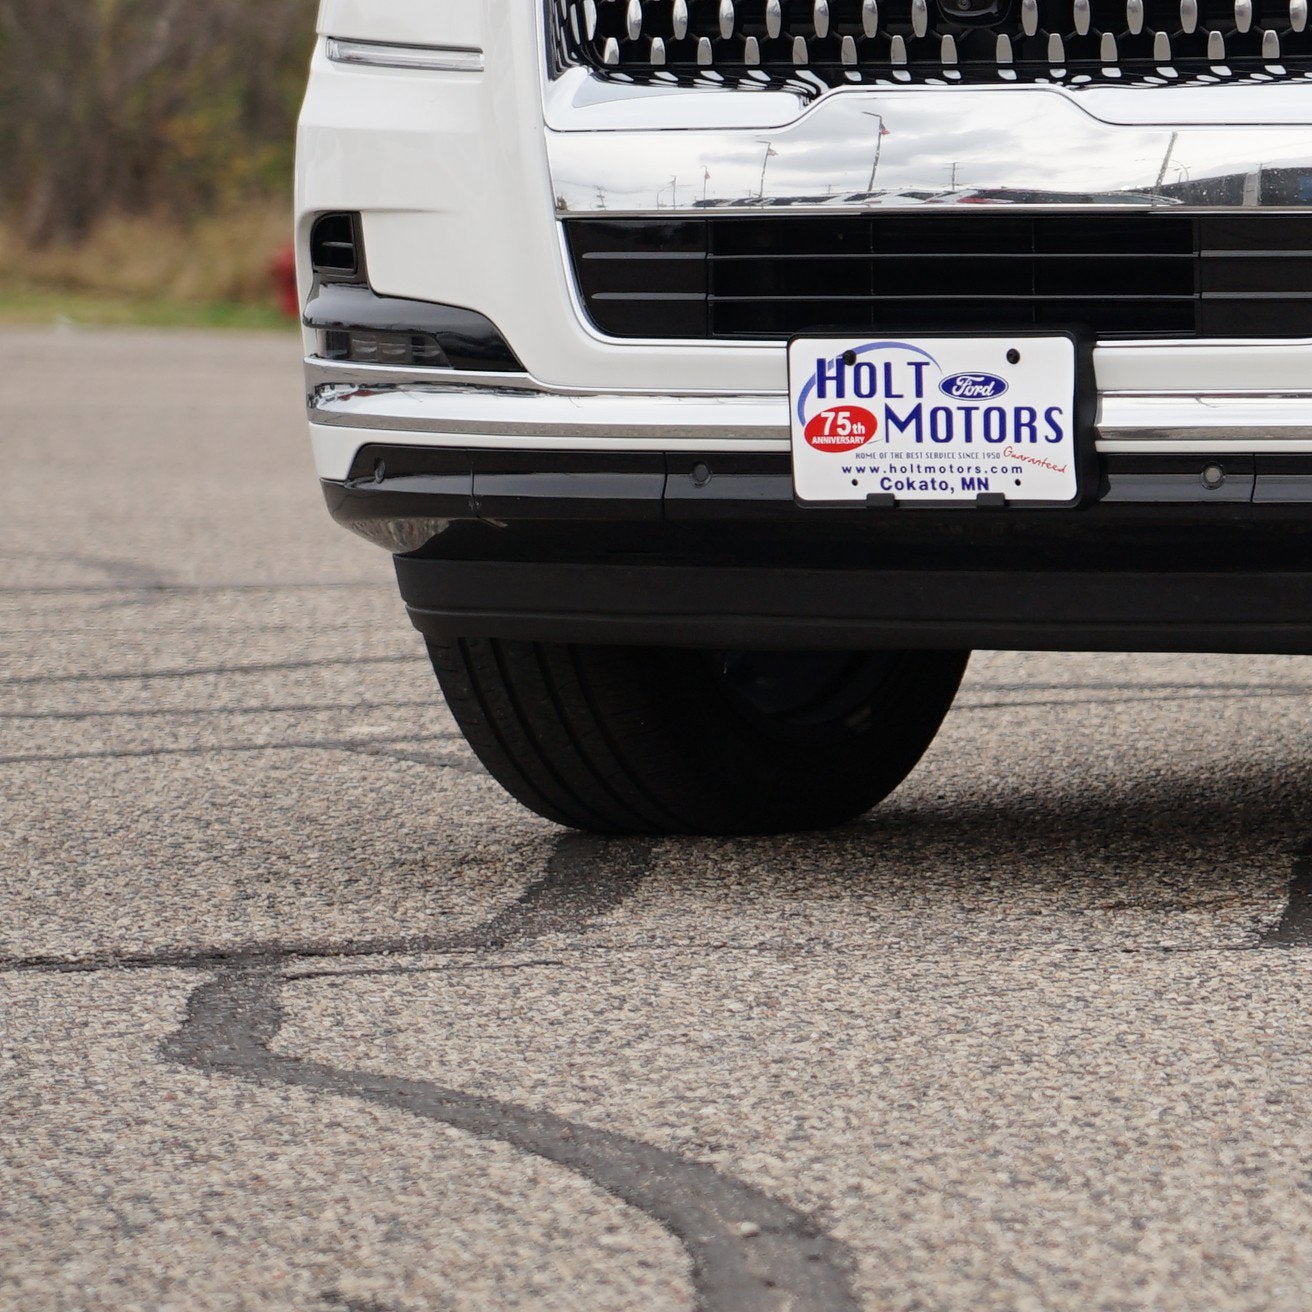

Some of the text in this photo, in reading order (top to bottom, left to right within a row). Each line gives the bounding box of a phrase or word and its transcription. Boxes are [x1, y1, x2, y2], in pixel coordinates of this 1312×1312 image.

[816, 358, 930, 399] HOLT
[951, 375, 995, 397] Ford
[820, 411, 866, 436] 75th
[885, 403, 1063, 443] MOTORS
[811, 435, 866, 444] ANNIVERSARY
[842, 463, 1023, 474] www.holtmotors.com
[1003, 446, 1067, 473] Guaranteed
[880, 477, 989, 493] Cokato, MN
